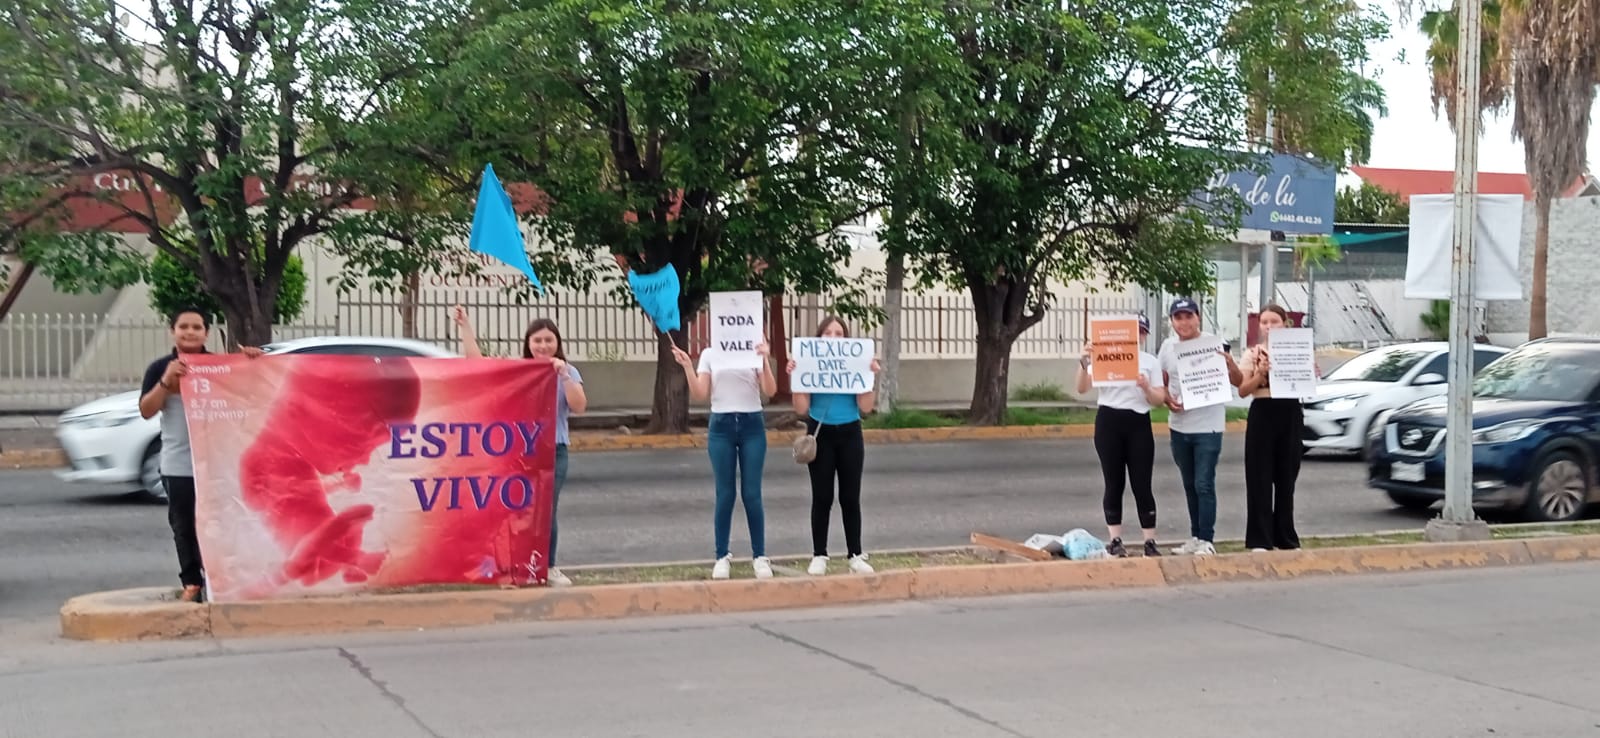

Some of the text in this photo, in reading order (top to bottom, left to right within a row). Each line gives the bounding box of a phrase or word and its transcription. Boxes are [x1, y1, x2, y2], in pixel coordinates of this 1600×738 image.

[1246, 174, 1271, 206] de
[1274, 173, 1297, 206] lu
[718, 315, 754, 326] TODA
[719, 341, 754, 352] VALE
[800, 340, 863, 358] MEXICO
[818, 359, 847, 371] DATE
[1096, 352, 1134, 362] ABORTO
[189, 364, 231, 374] Semana
[192, 378, 210, 394] 13
[800, 372, 866, 389] CUENTA
[387, 420, 544, 459] ESTOY
[410, 475, 534, 512] VIVO
